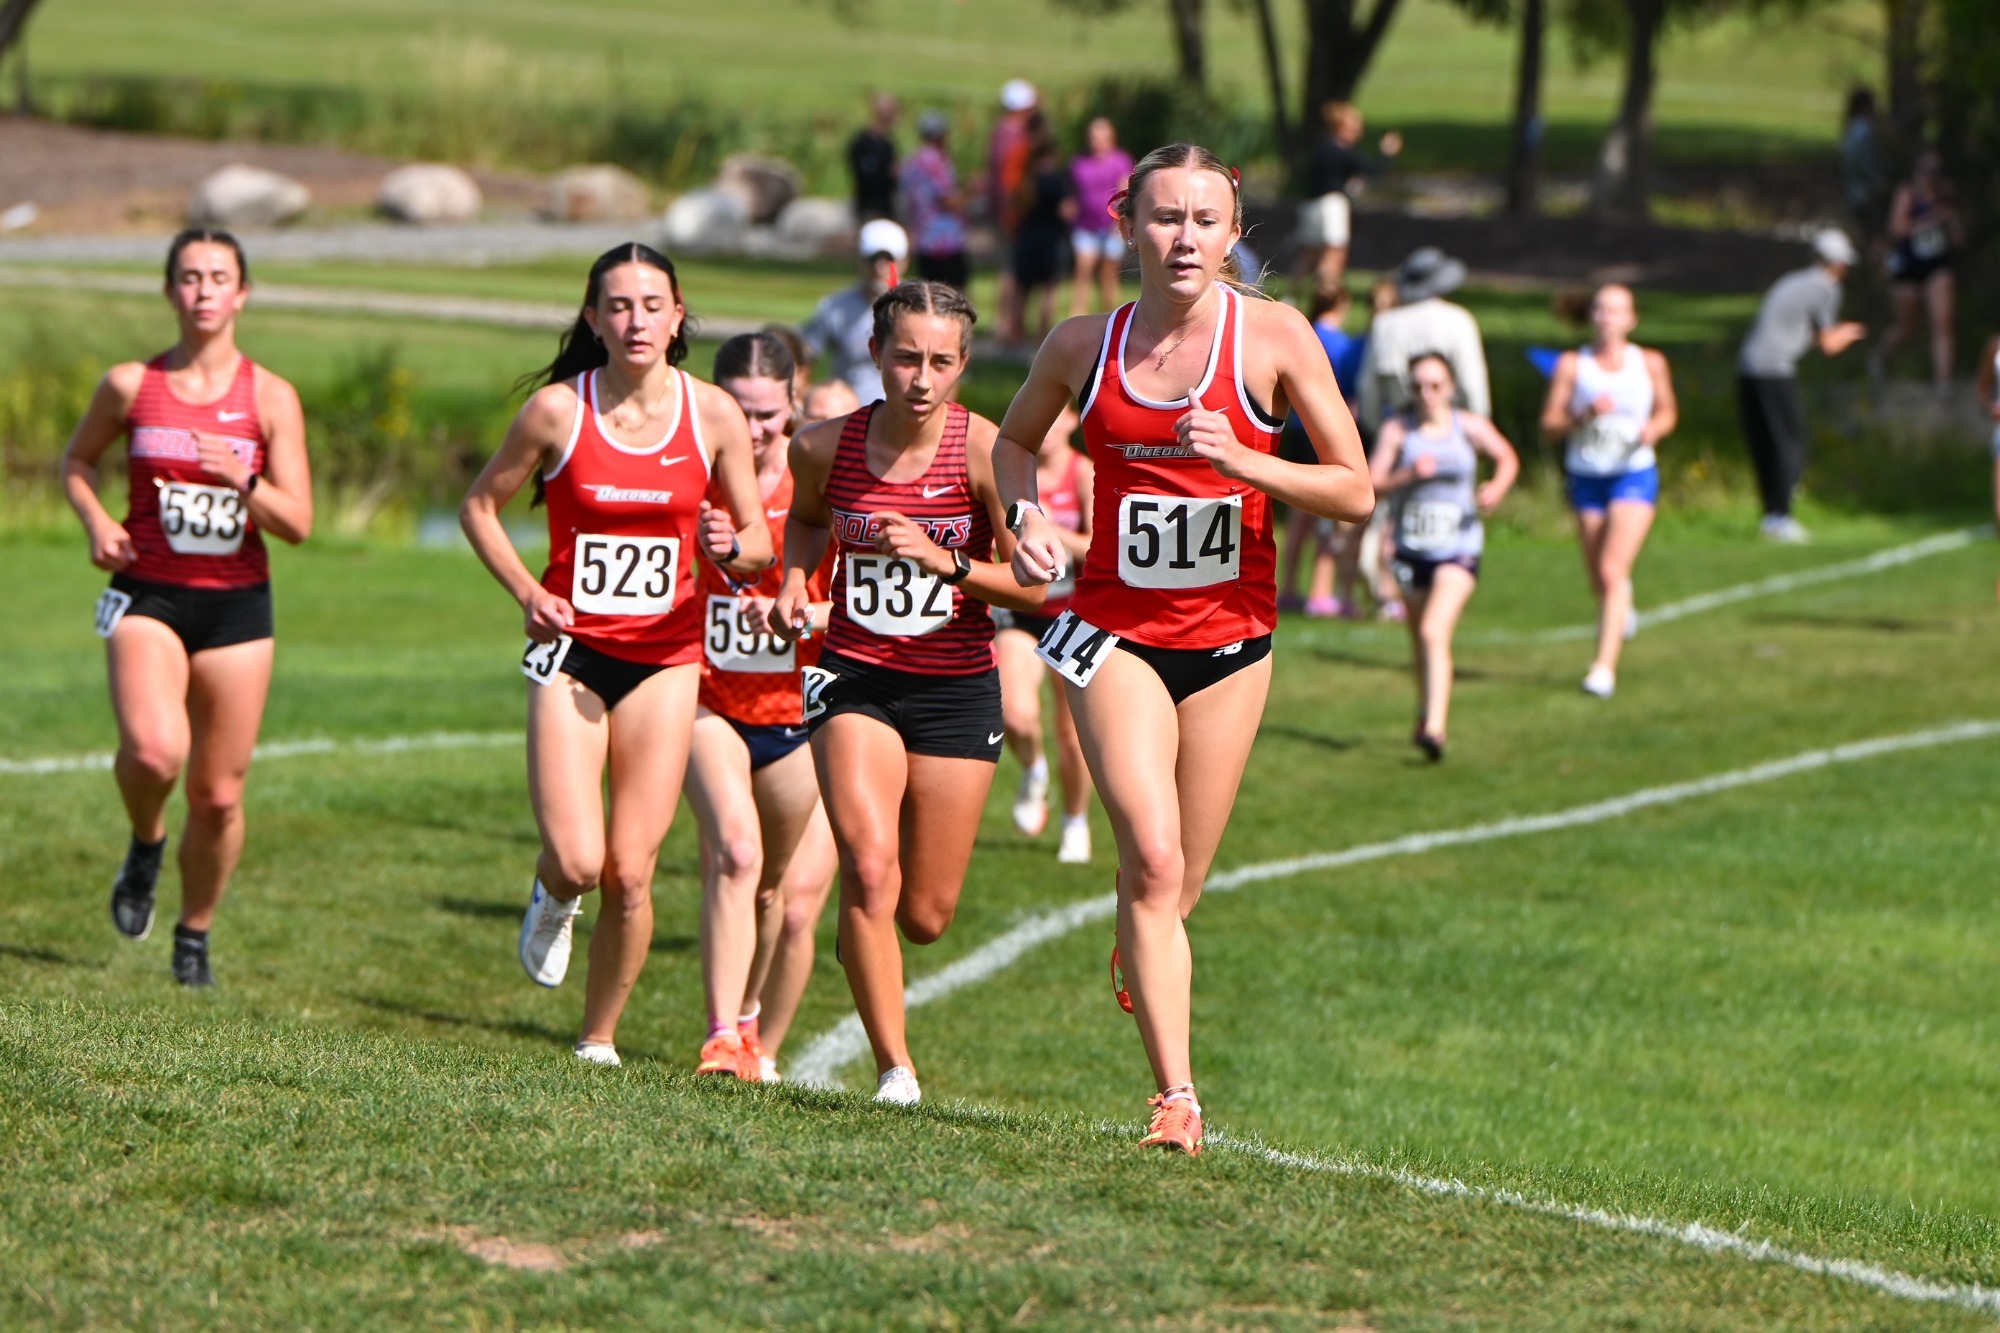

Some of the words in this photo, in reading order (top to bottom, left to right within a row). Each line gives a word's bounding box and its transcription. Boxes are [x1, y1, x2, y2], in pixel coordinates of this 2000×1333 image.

[166, 490, 241, 540] 533
[832, 509, 972, 547] ROBTS
[1128, 501, 1236, 569] 514
[581, 541, 672, 598] 523
[853, 559, 948, 617] 532
[801, 671, 826, 713] 2
